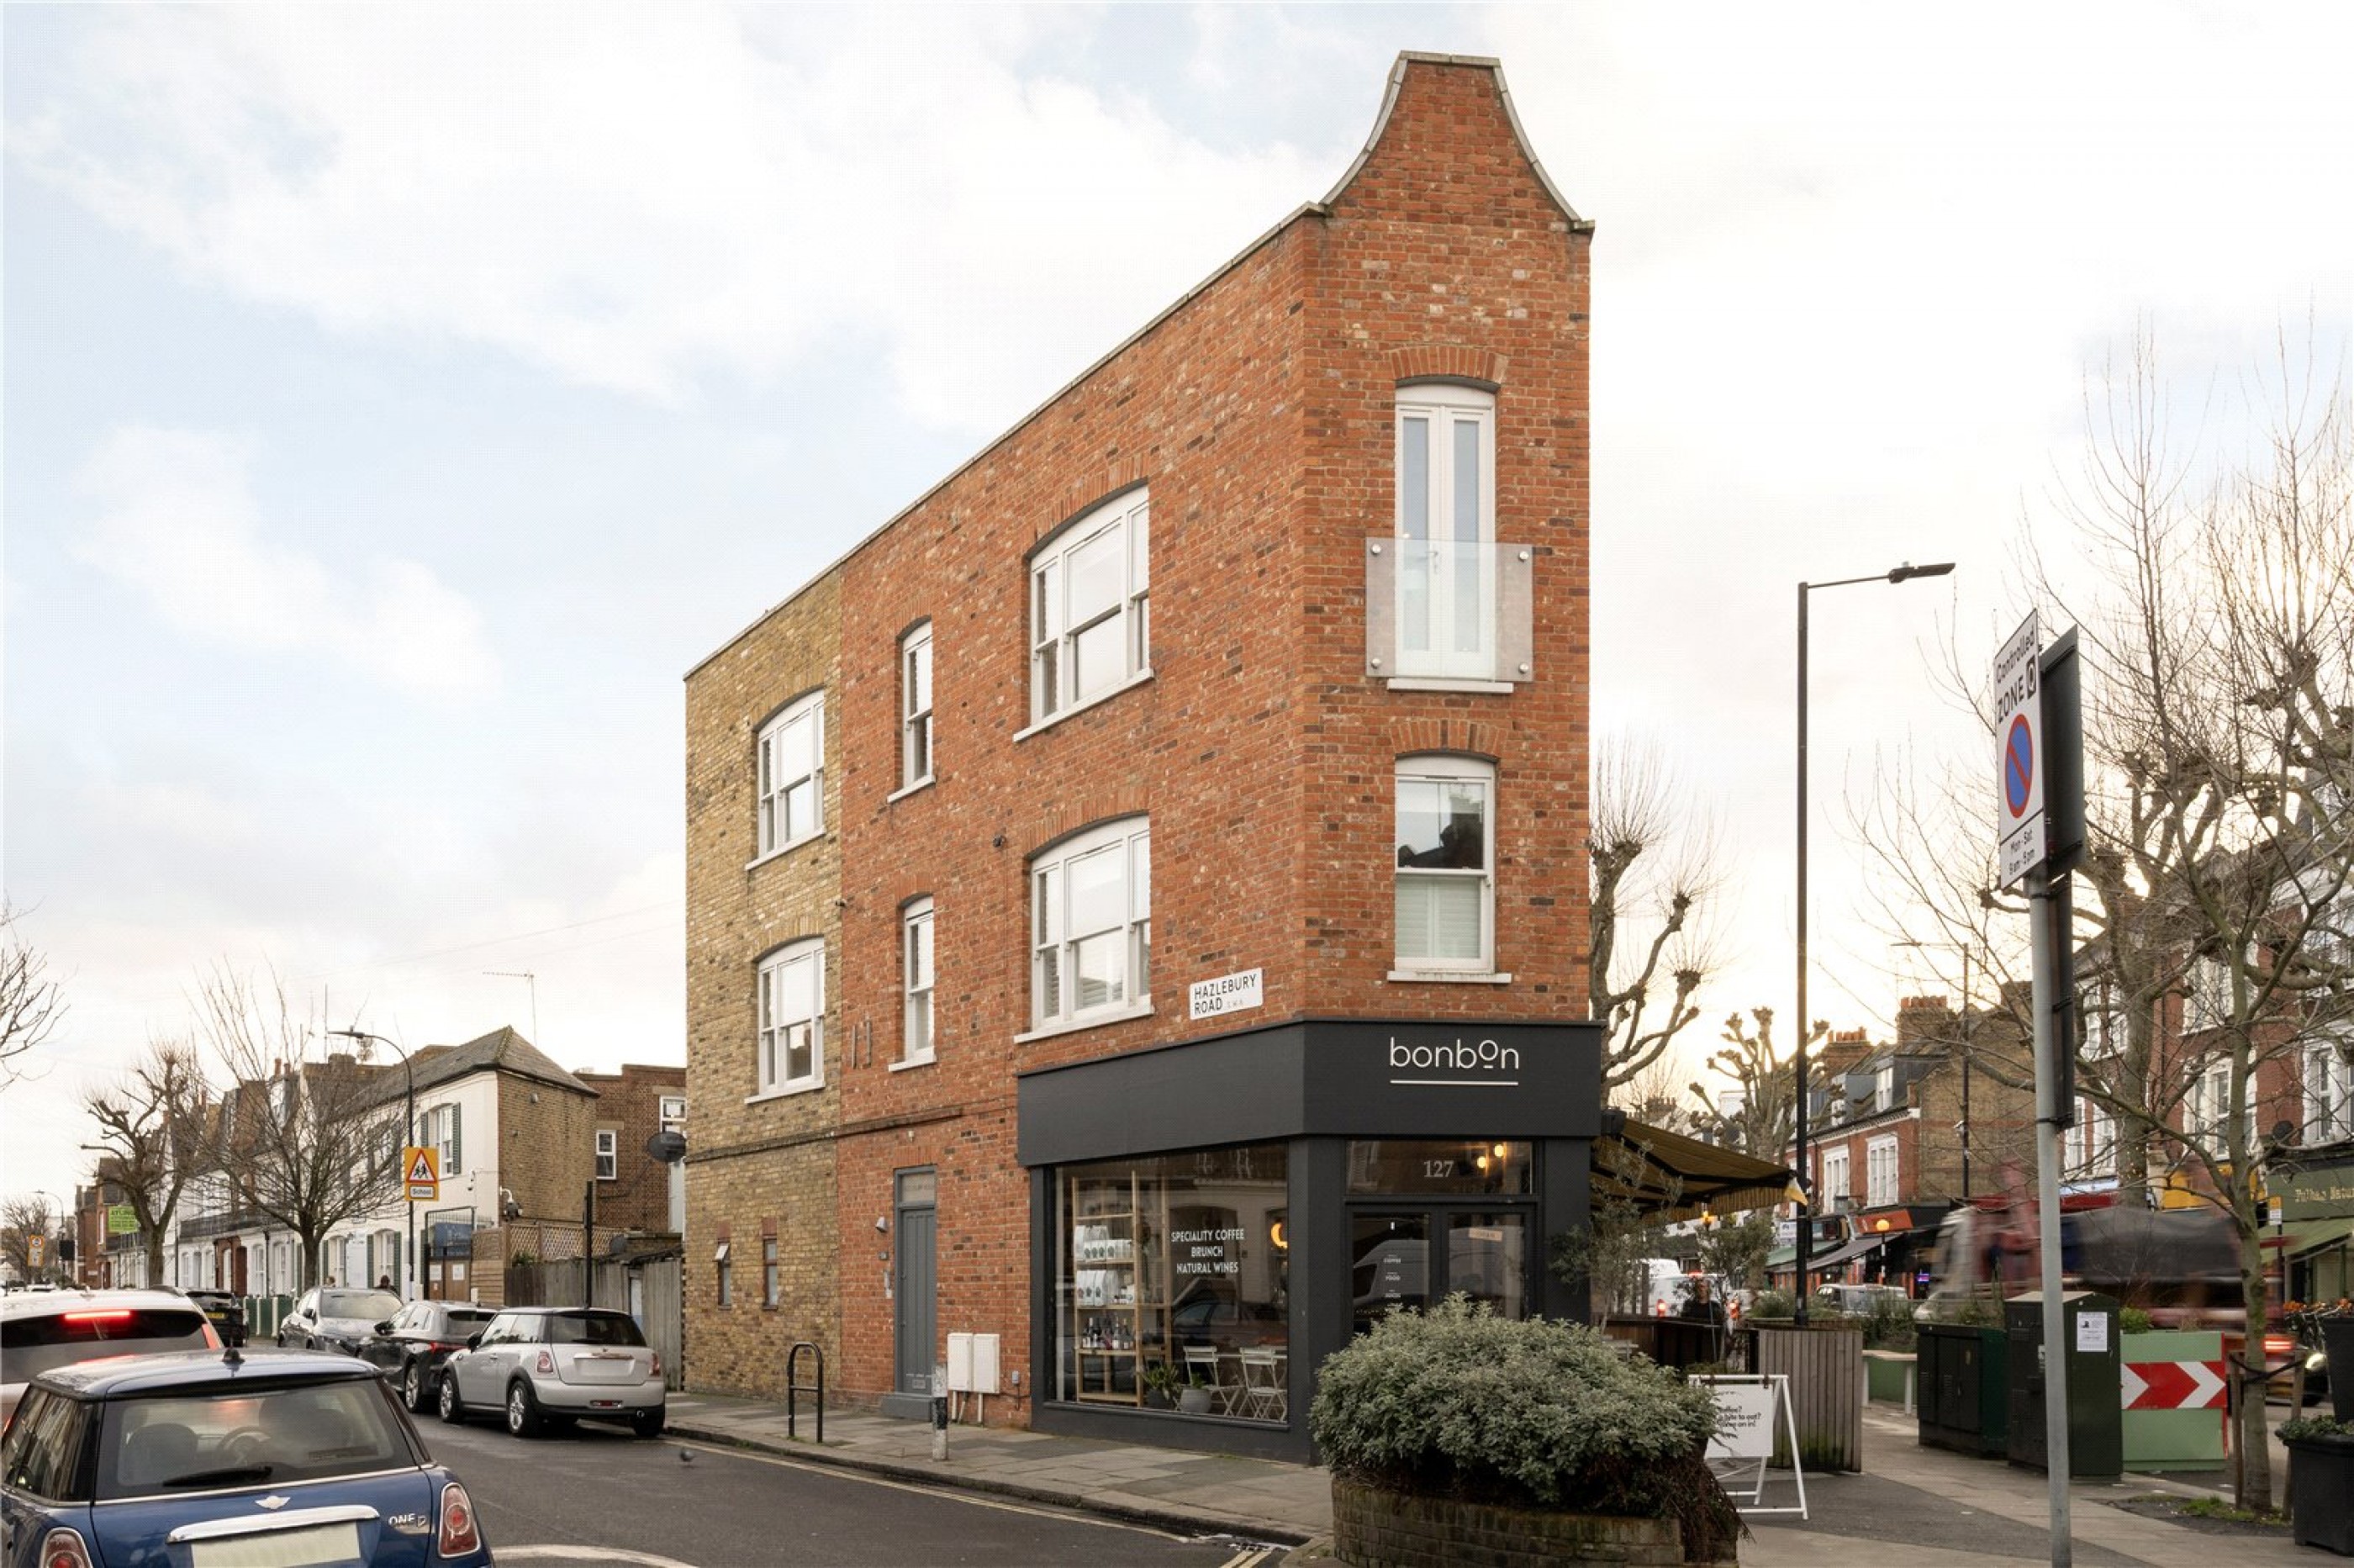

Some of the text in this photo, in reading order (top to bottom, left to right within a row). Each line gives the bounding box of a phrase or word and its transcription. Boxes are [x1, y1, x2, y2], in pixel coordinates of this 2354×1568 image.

[1998, 675, 2024, 724] ZONE
[1194, 973, 1257, 1000] HAZLEBURY
[1194, 996, 1223, 1016] ROAD
[1390, 1036, 1519, 1069] bonbon
[1423, 1159, 1454, 1178] 127
[1171, 1228, 1245, 1242] SPECIALITY COFFEE
[1191, 1246, 1223, 1257] BRUNCH
[1176, 1262, 1238, 1274] NATURAL WINES
[388, 1513, 415, 1526] ONE
